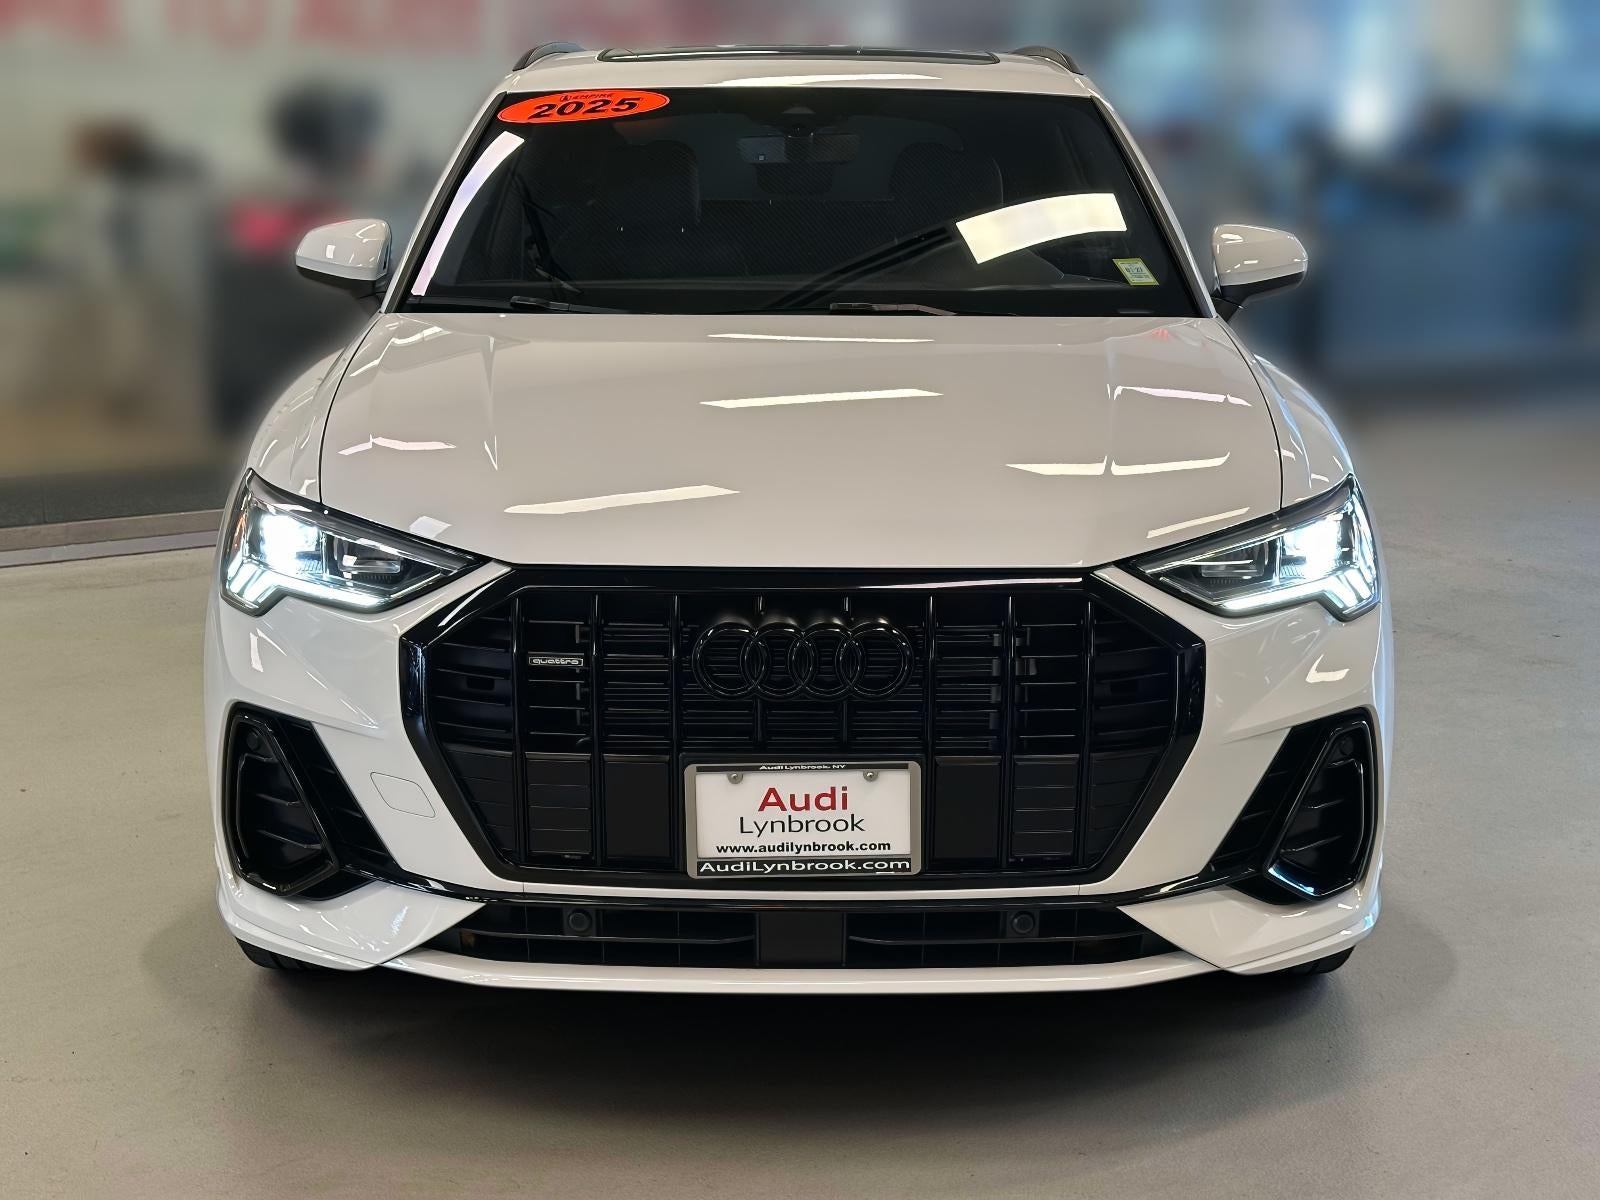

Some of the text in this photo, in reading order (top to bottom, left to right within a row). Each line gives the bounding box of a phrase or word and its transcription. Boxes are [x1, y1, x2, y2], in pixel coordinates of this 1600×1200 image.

[528, 98, 641, 120] 2025
[758, 786, 848, 812] Audi
[739, 814, 865, 838] Lynbrook
[716, 841, 891, 855] www.audilynbrook.com
[700, 859, 910, 874] AudiLynbrook.com
